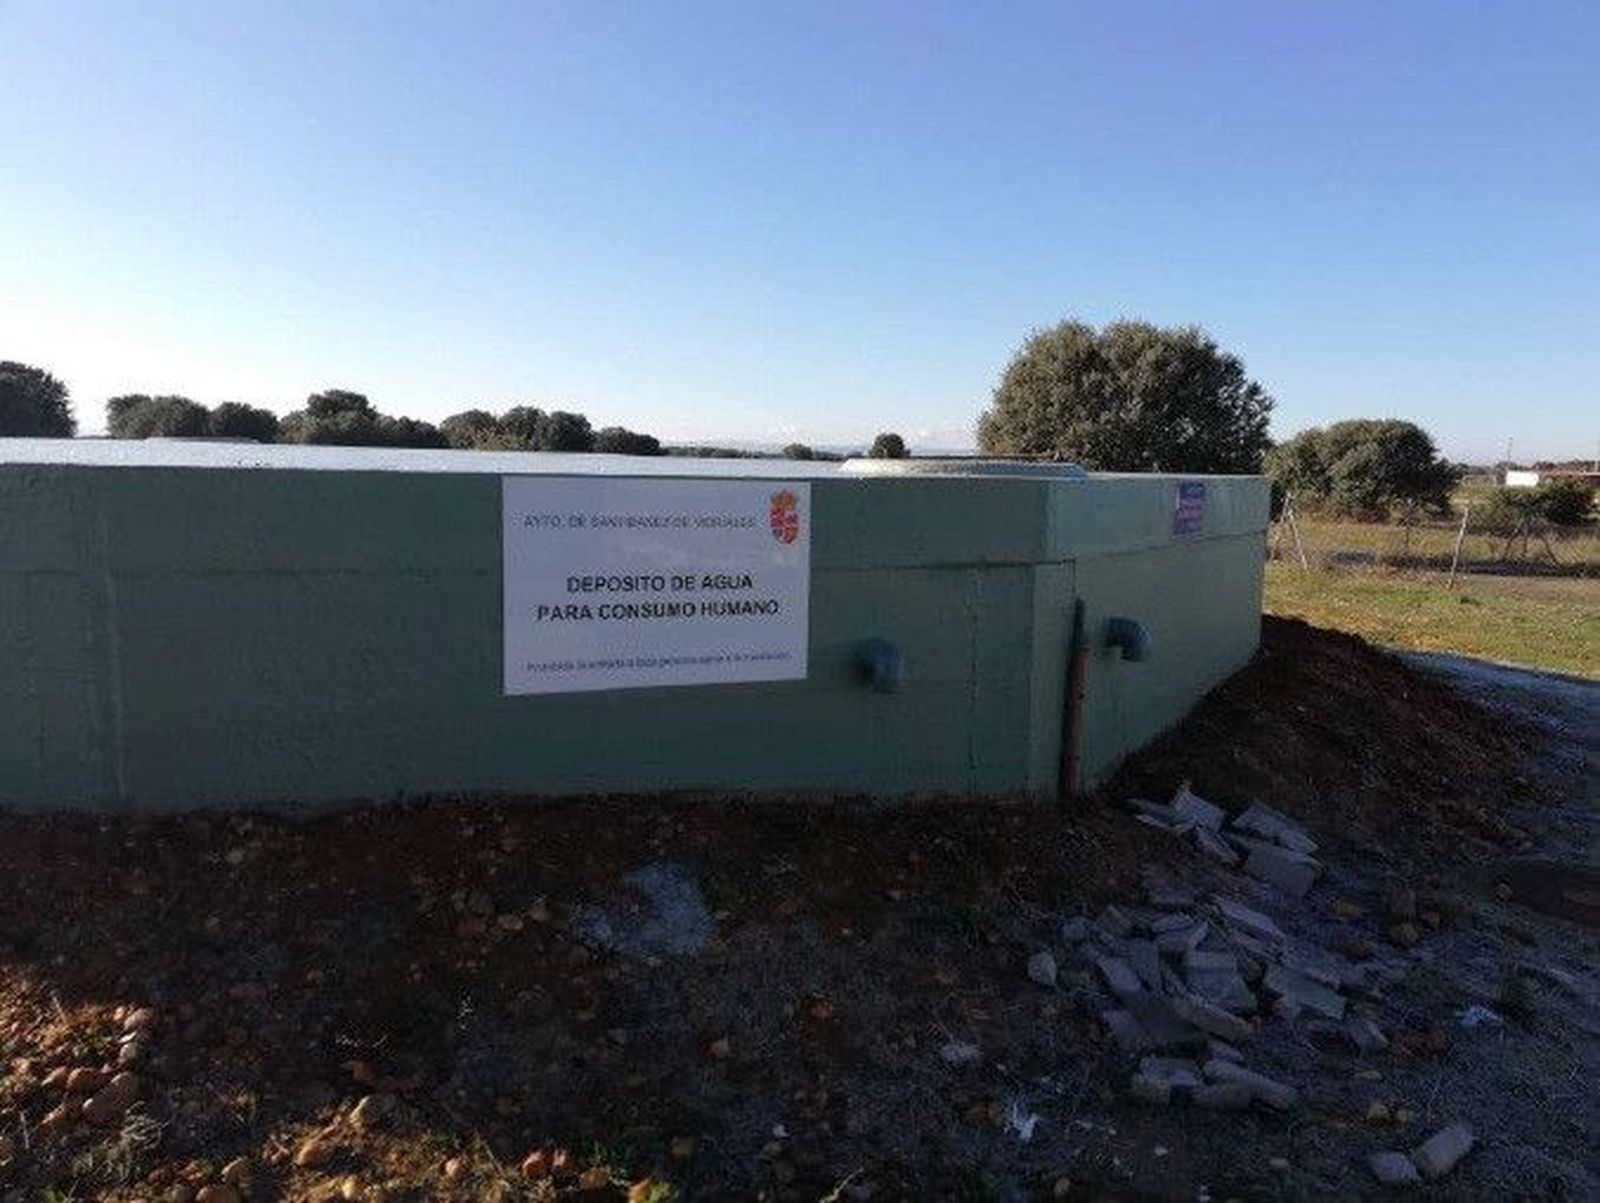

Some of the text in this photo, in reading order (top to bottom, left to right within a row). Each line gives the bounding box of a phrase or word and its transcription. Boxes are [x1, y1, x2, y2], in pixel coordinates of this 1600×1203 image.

[567, 574, 752, 593] DEPOSITO DE AGUA
[537, 599, 779, 621] PARA CONSUMO HUMANO
